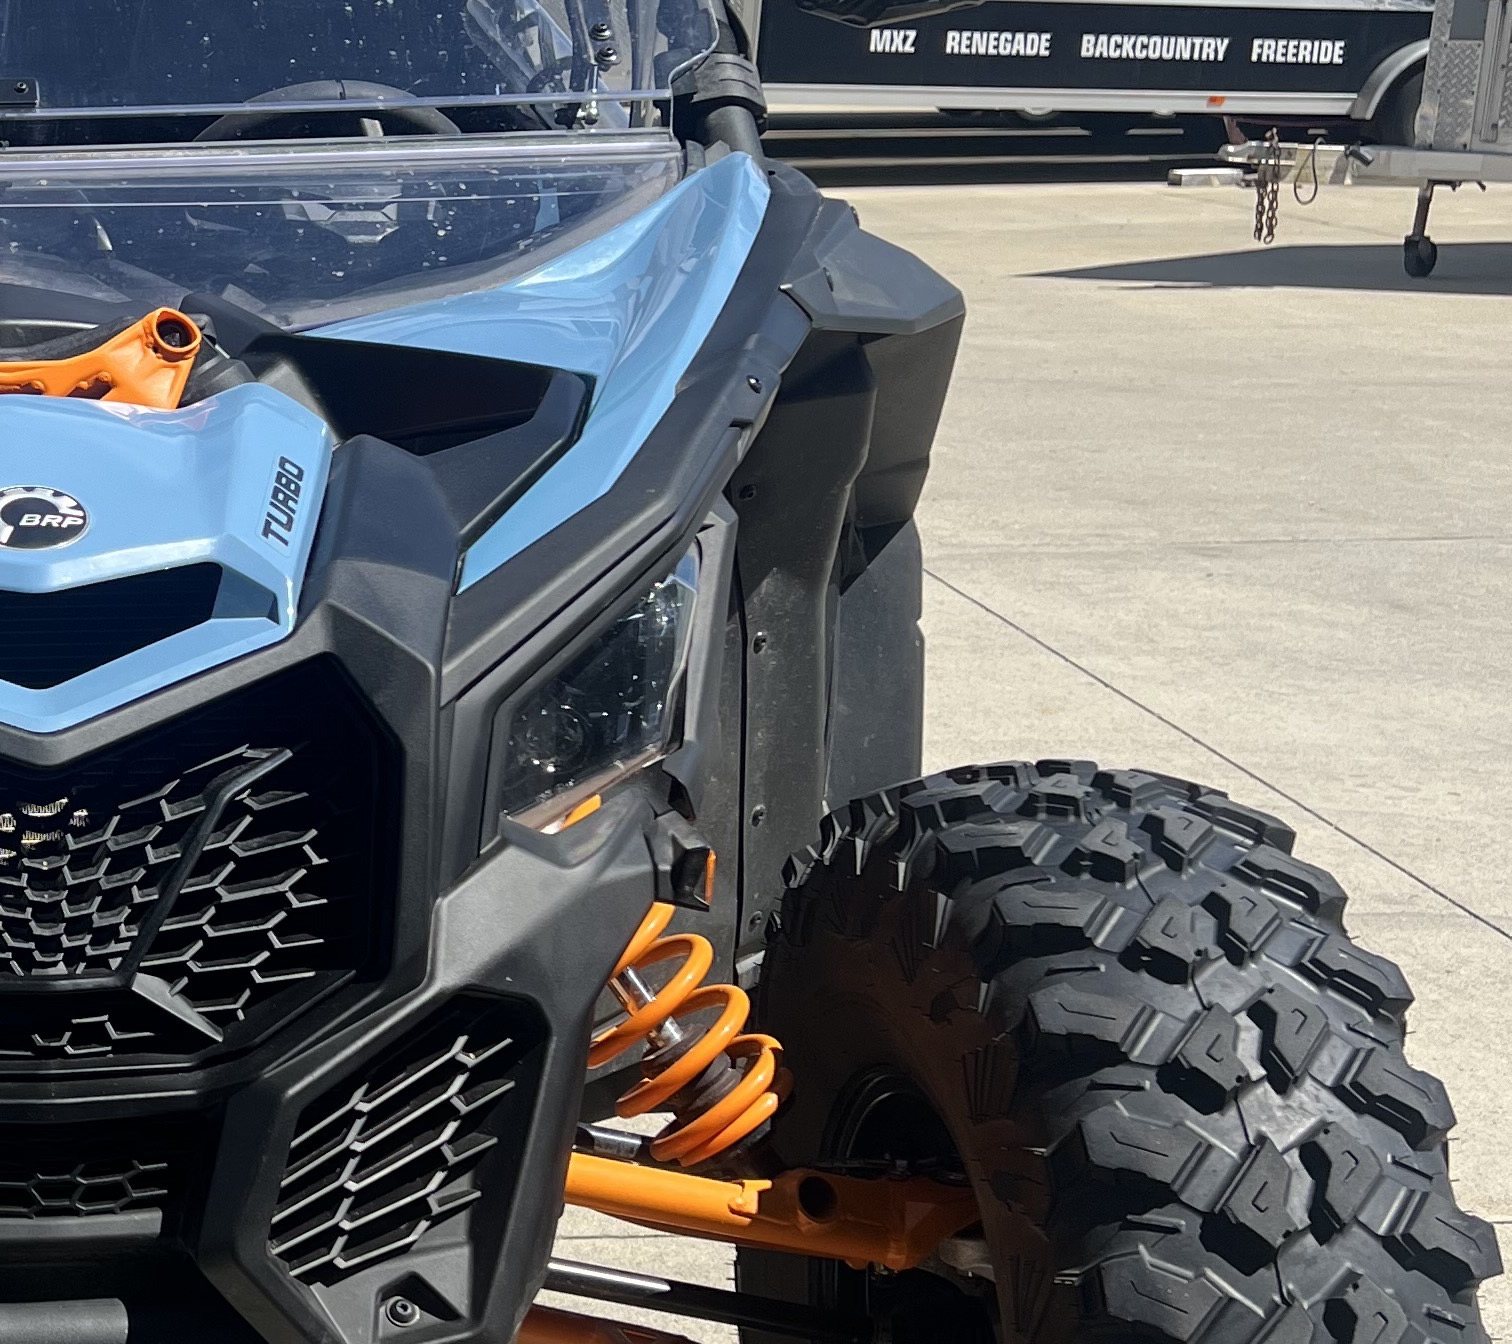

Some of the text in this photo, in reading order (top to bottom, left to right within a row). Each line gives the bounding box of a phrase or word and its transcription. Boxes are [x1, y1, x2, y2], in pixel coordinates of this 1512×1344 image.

[869, 29, 1346, 65] MXZ RENEGADE BACKCOUNTRY FREERIDE
[261, 455, 305, 547] TURBO
[18, 513, 84, 528] BRP
